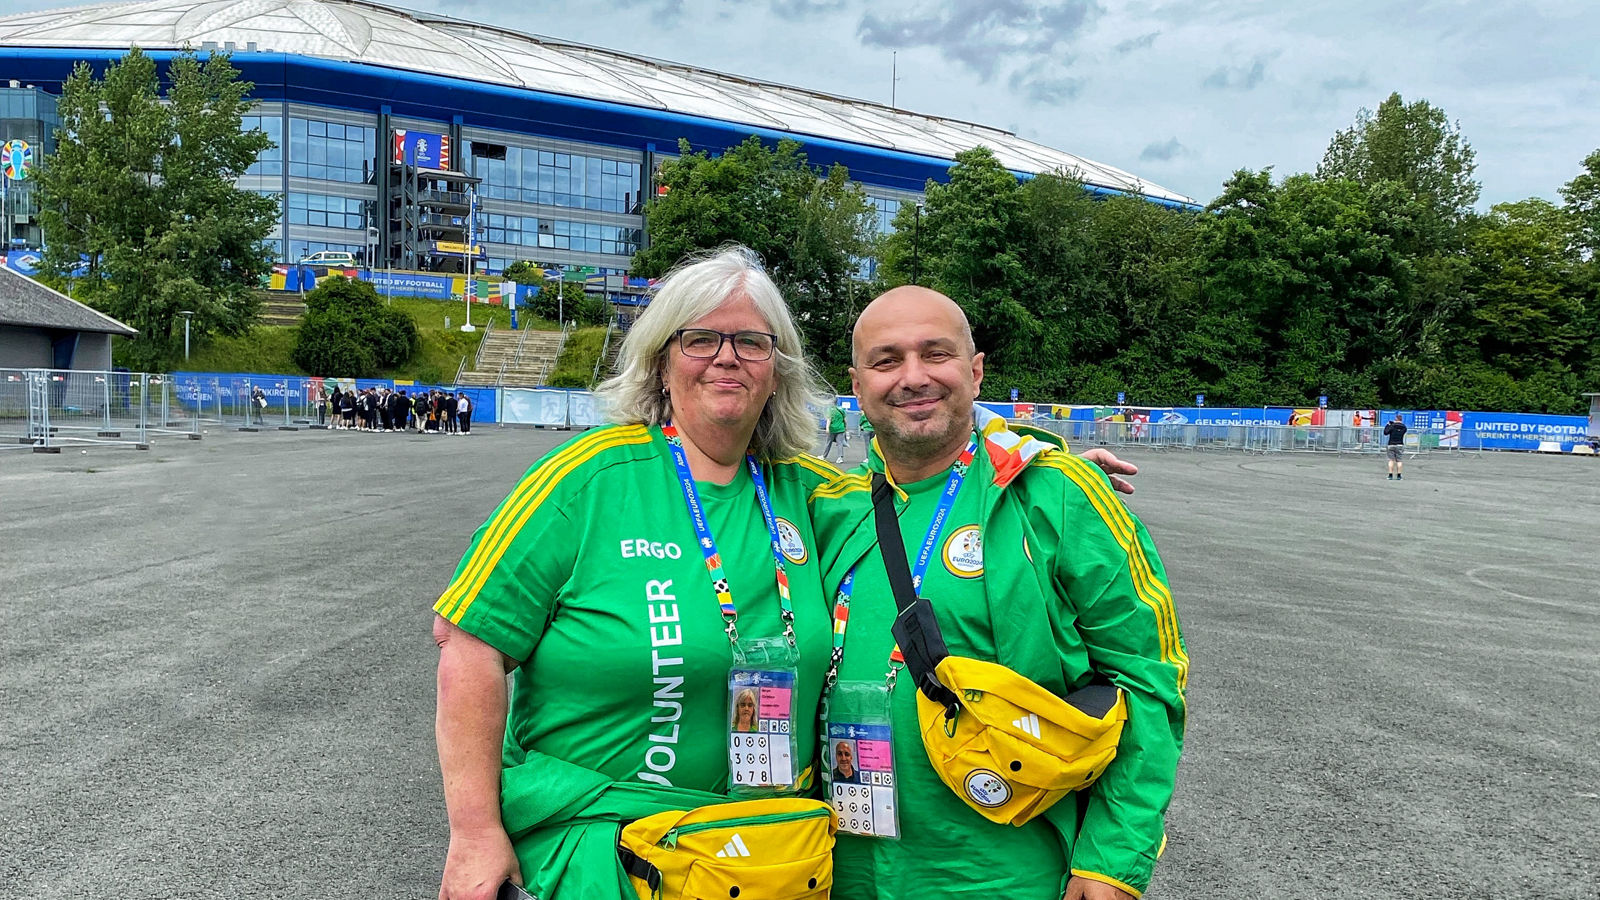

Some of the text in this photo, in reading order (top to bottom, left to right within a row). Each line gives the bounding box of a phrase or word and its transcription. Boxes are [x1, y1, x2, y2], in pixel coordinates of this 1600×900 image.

[406, 280, 444, 288] FOOTBALL
[1475, 422, 1519, 431] UNITED
[1521, 424, 1536, 432] BY
[620, 538, 682, 560] ERGO
[733, 736, 741, 748] 0
[735, 753, 742, 765] 3
[736, 770, 767, 782] 6 7 8
[836, 785, 843, 796] 0
[837, 801, 844, 812] 3
